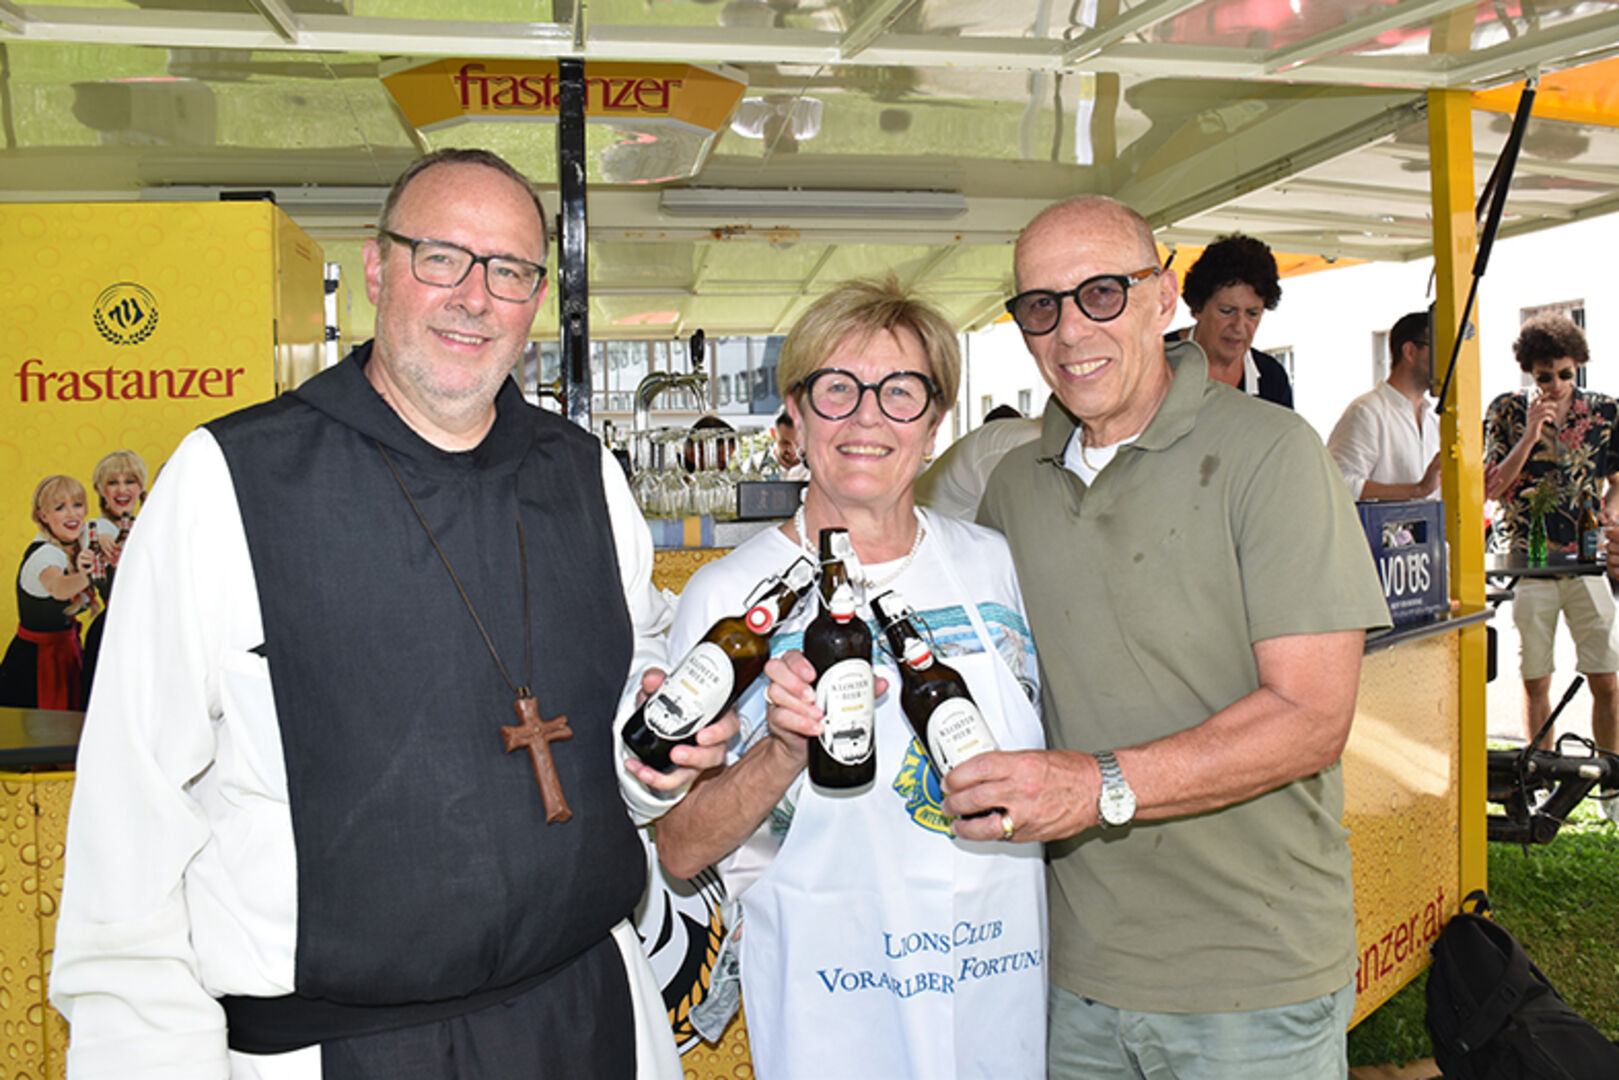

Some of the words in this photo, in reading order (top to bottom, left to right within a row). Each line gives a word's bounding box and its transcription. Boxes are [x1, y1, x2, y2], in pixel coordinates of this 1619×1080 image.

[453, 63, 683, 110] frastnzer
[14, 358, 246, 402] frastanzer
[882, 931, 951, 959] LIONS
[952, 920, 1003, 948] CLUB
[958, 949, 1044, 982] FORTUN
